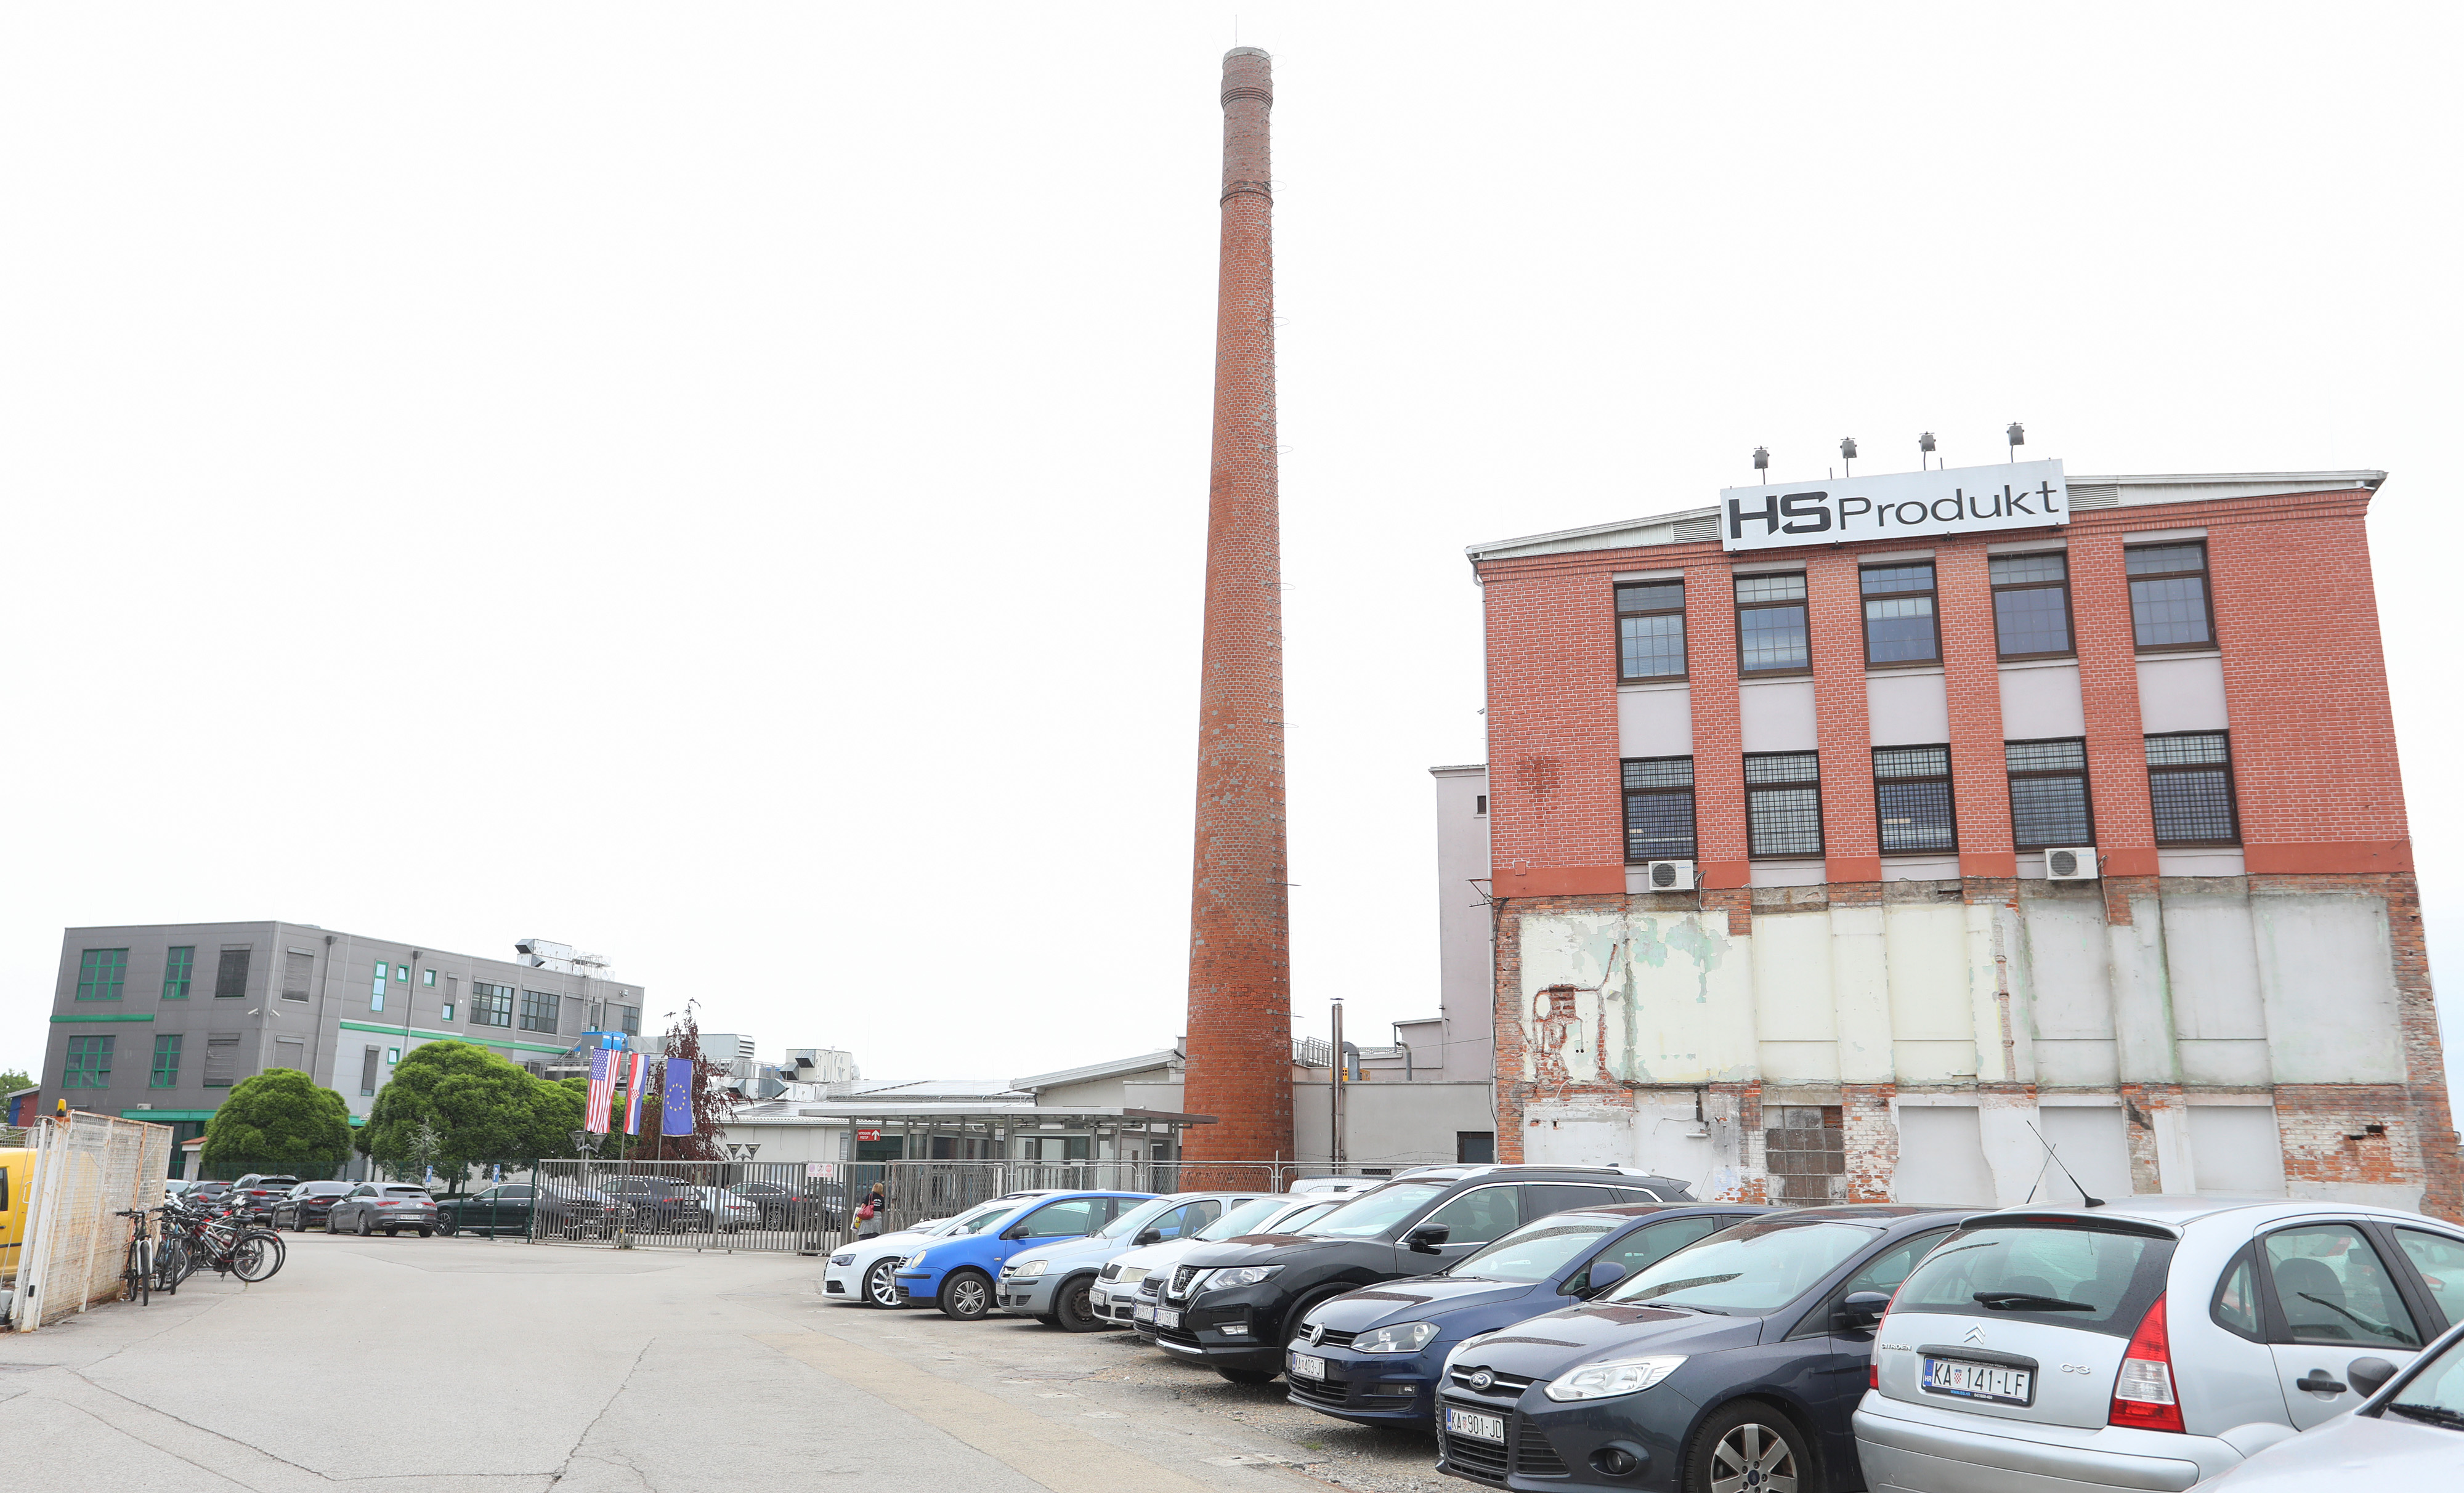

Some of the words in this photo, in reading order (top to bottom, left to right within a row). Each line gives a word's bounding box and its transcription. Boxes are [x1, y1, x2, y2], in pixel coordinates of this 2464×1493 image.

[426, 1168, 431, 1181] P
[493, 1167, 498, 1180] P
[1934, 1362, 1951, 1386] KA
[2059, 1362, 2091, 1375] C3
[1472, 1374, 1485, 1385] Ford
